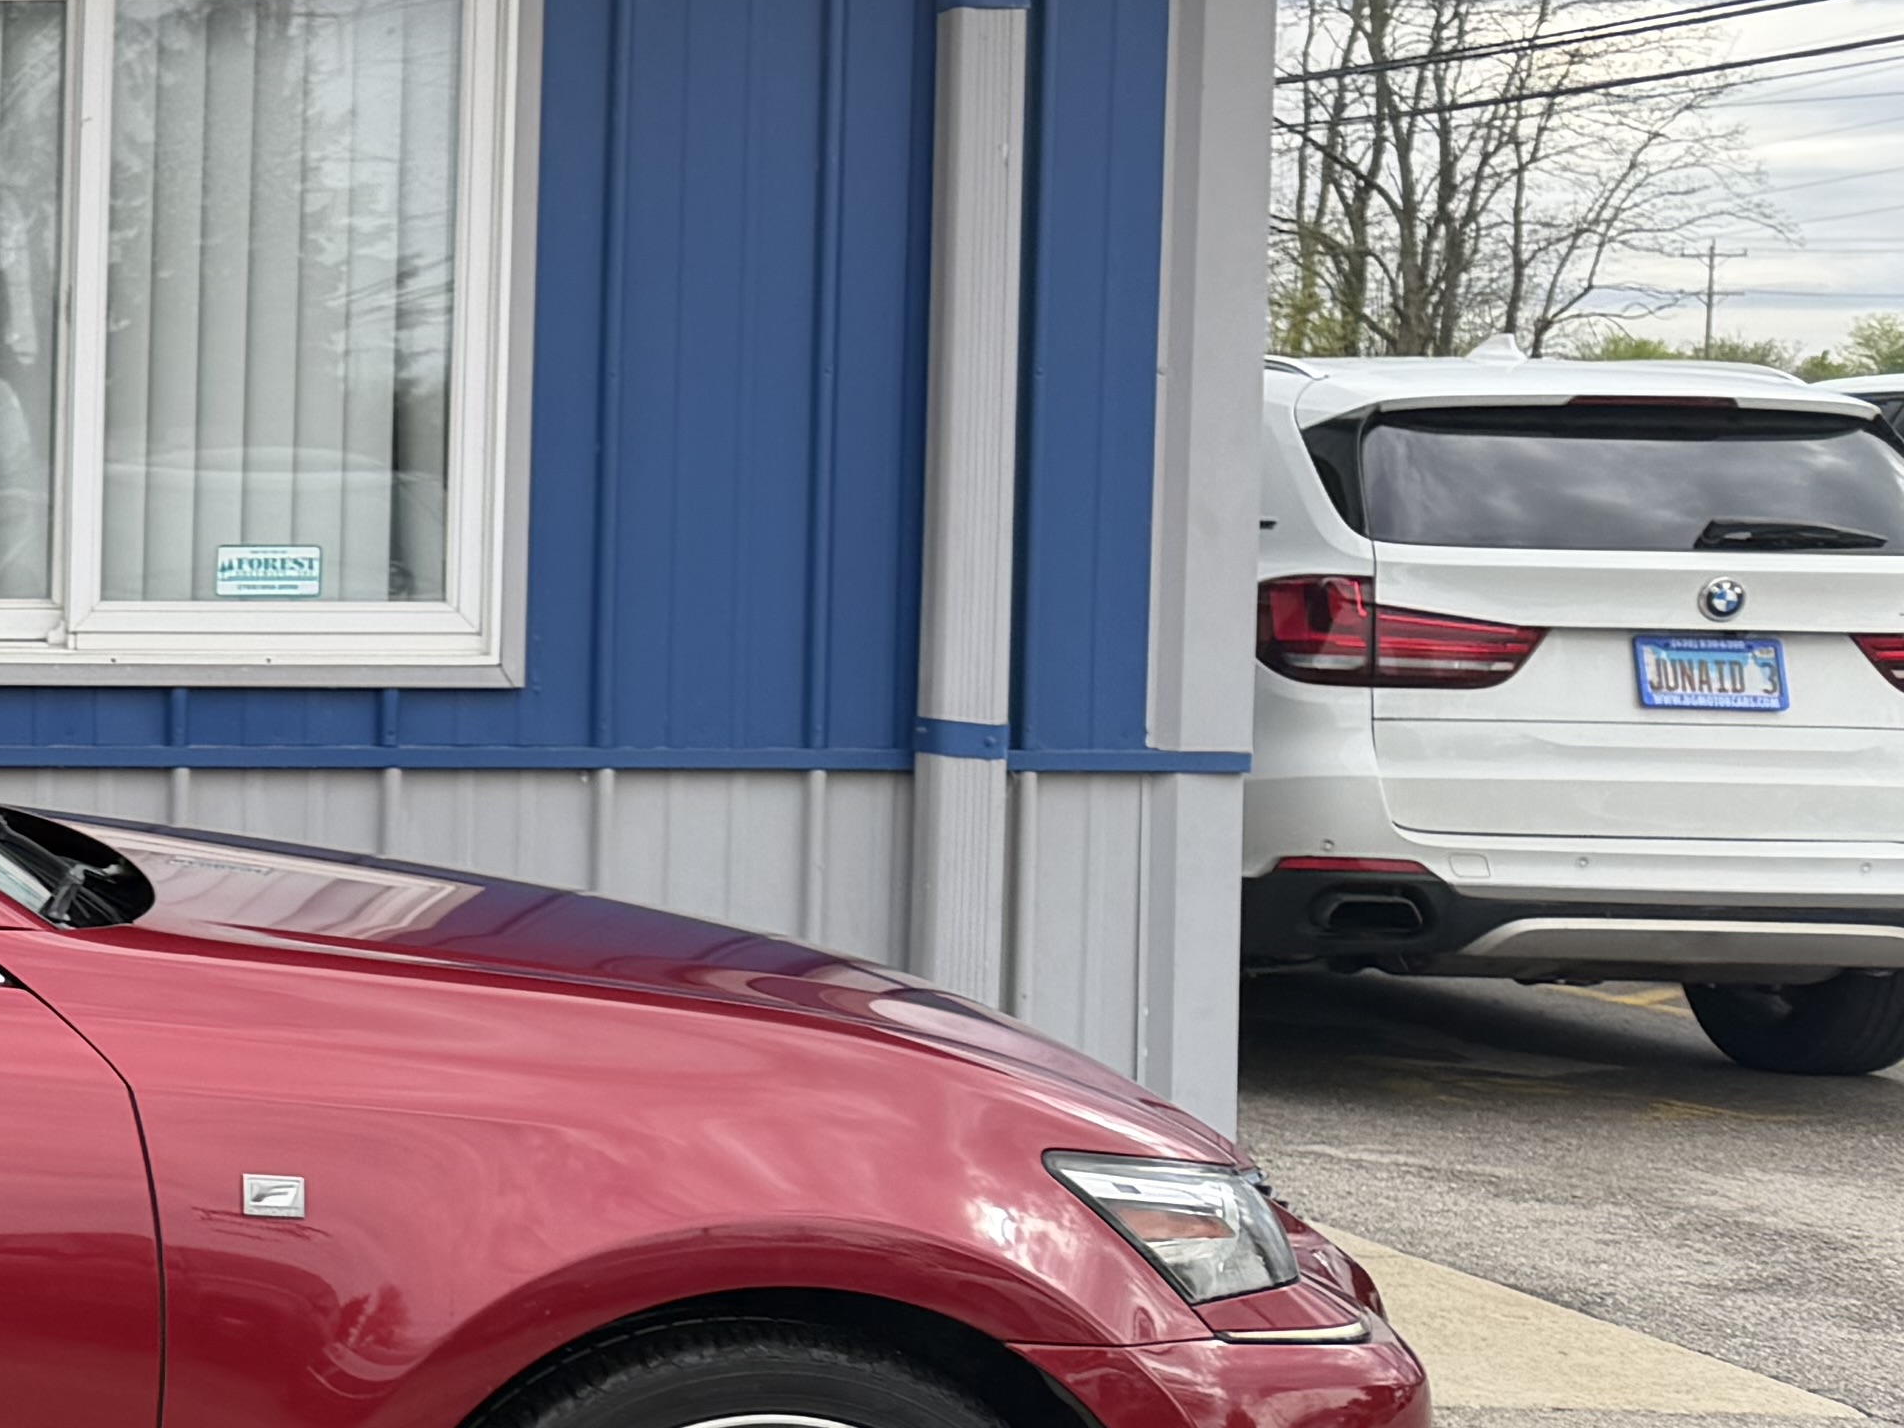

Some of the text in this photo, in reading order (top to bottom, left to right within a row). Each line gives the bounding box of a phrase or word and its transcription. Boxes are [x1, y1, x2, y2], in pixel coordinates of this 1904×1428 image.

[237, 556, 318, 571] FOREST
[1649, 658, 1778, 695] JUNAID 3
